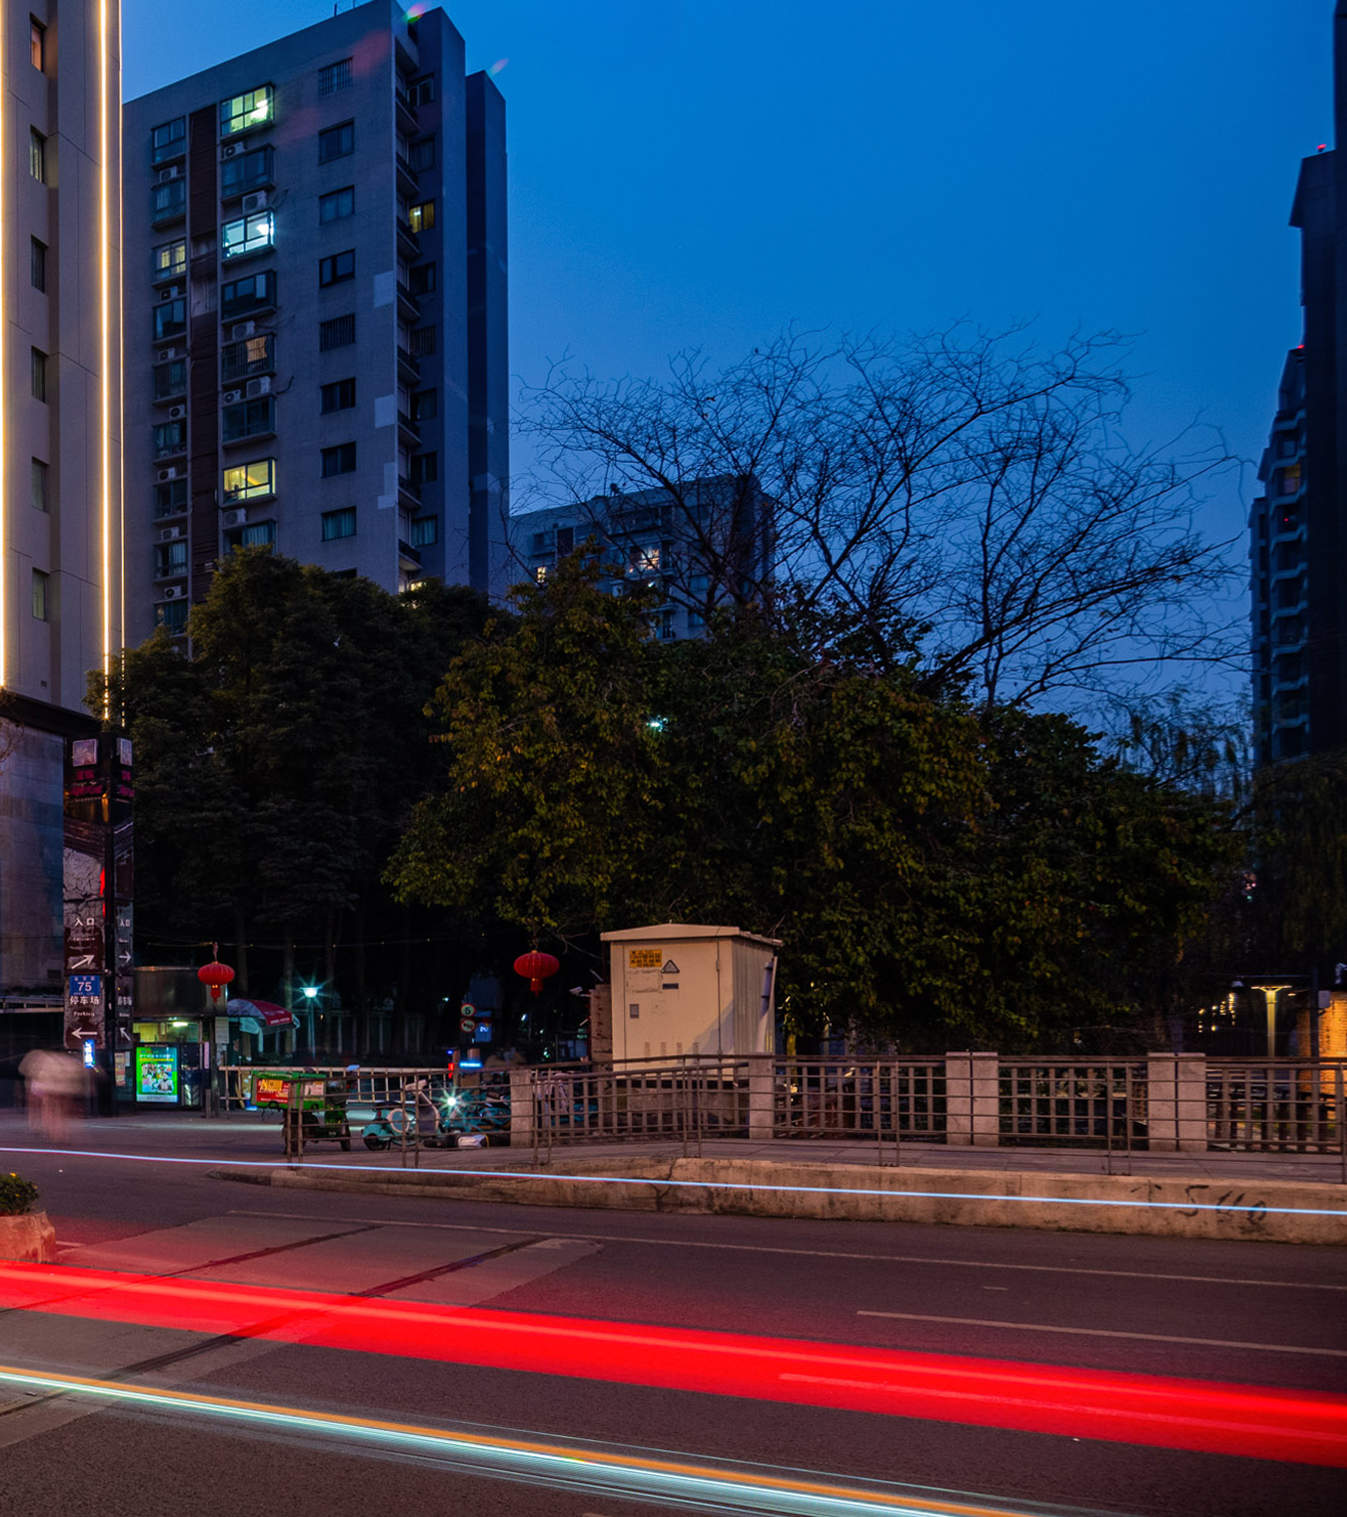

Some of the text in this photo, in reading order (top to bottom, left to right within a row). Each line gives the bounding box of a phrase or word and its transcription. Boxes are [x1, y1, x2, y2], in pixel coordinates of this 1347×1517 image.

[74, 917, 95, 926] 入口
[77, 981, 92, 992] 75
[70, 995, 100, 1005] 停车场
